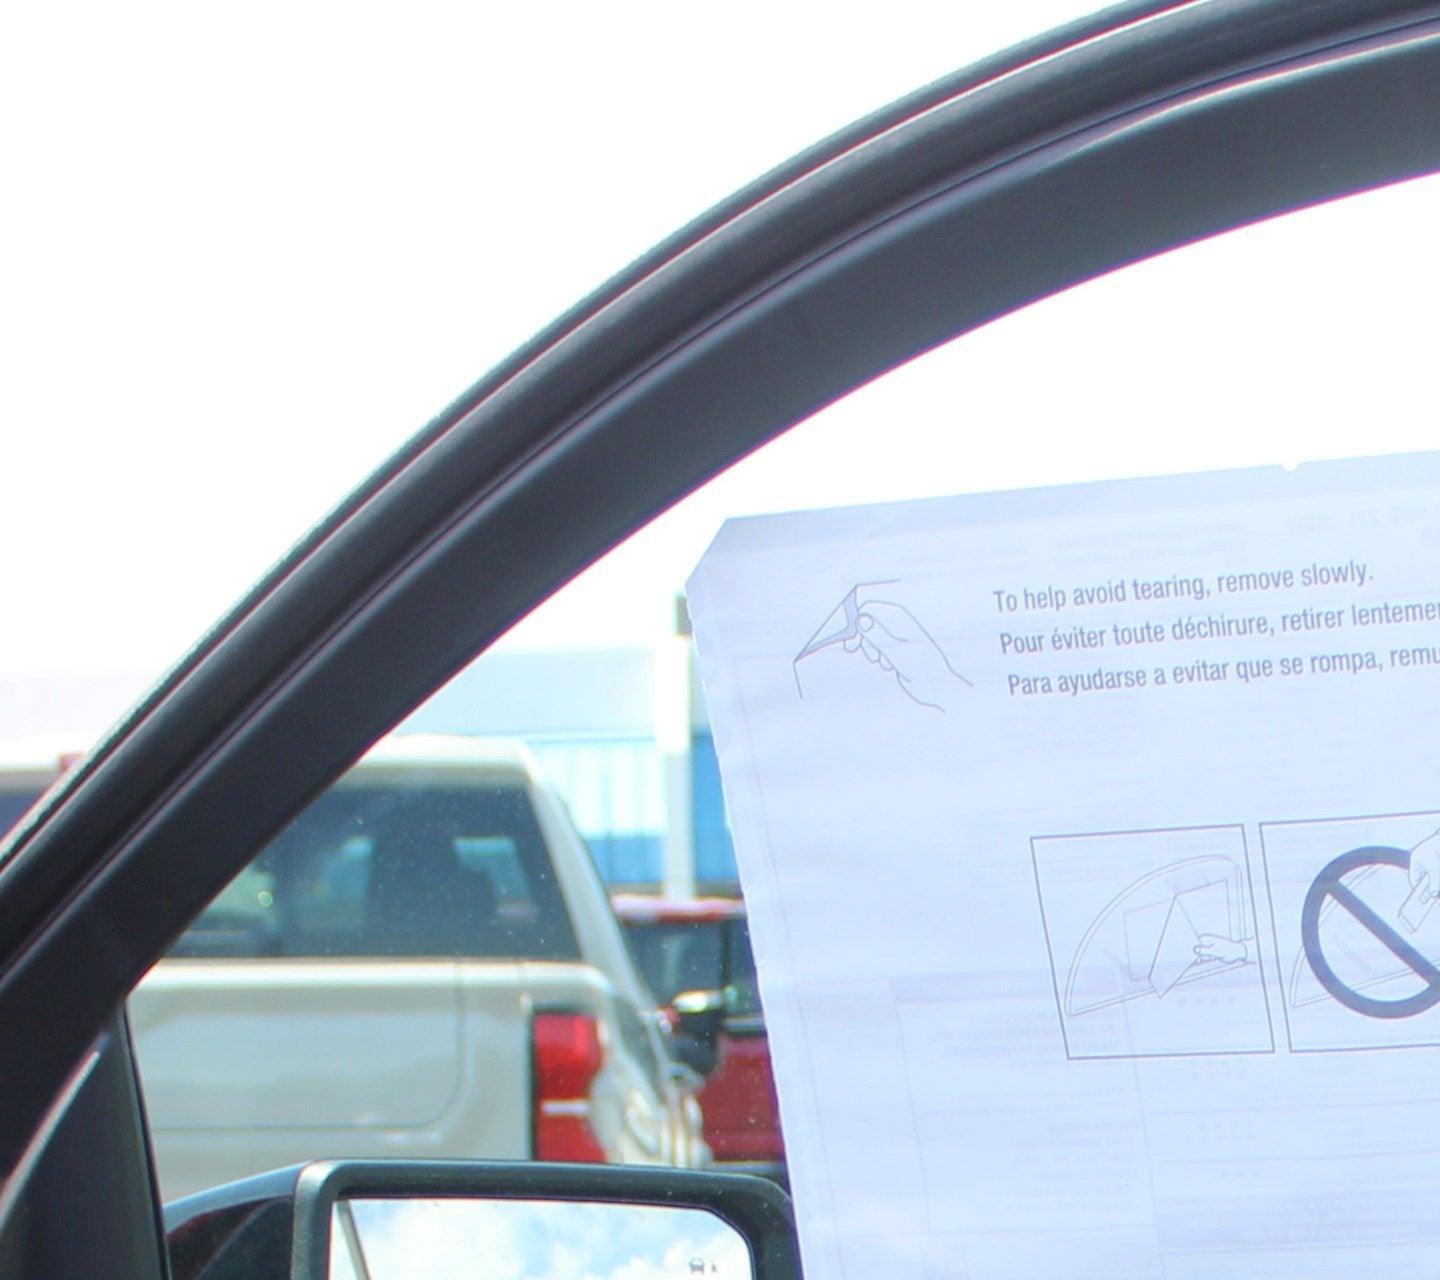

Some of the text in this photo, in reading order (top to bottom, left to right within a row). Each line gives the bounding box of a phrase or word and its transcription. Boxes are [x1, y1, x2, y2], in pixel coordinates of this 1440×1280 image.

[992, 558, 1375, 614] To help avoid tearing, remove slowly.
[999, 630, 1045, 656] Pour
[1050, 622, 1107, 652] éviter
[1112, 617, 1166, 645] toute
[1171, 611, 1276, 643] déchirure,
[1280, 605, 1345, 635] retirer
[1007, 672, 1054, 697] Para
[1057, 664, 1148, 698] ayudarse
[1153, 669, 1167, 686] a
[1172, 658, 1231, 685] evitar
[1235, 660, 1275, 687] que
[1279, 657, 1305, 679] se
[1308, 650, 1385, 680] rompa,
